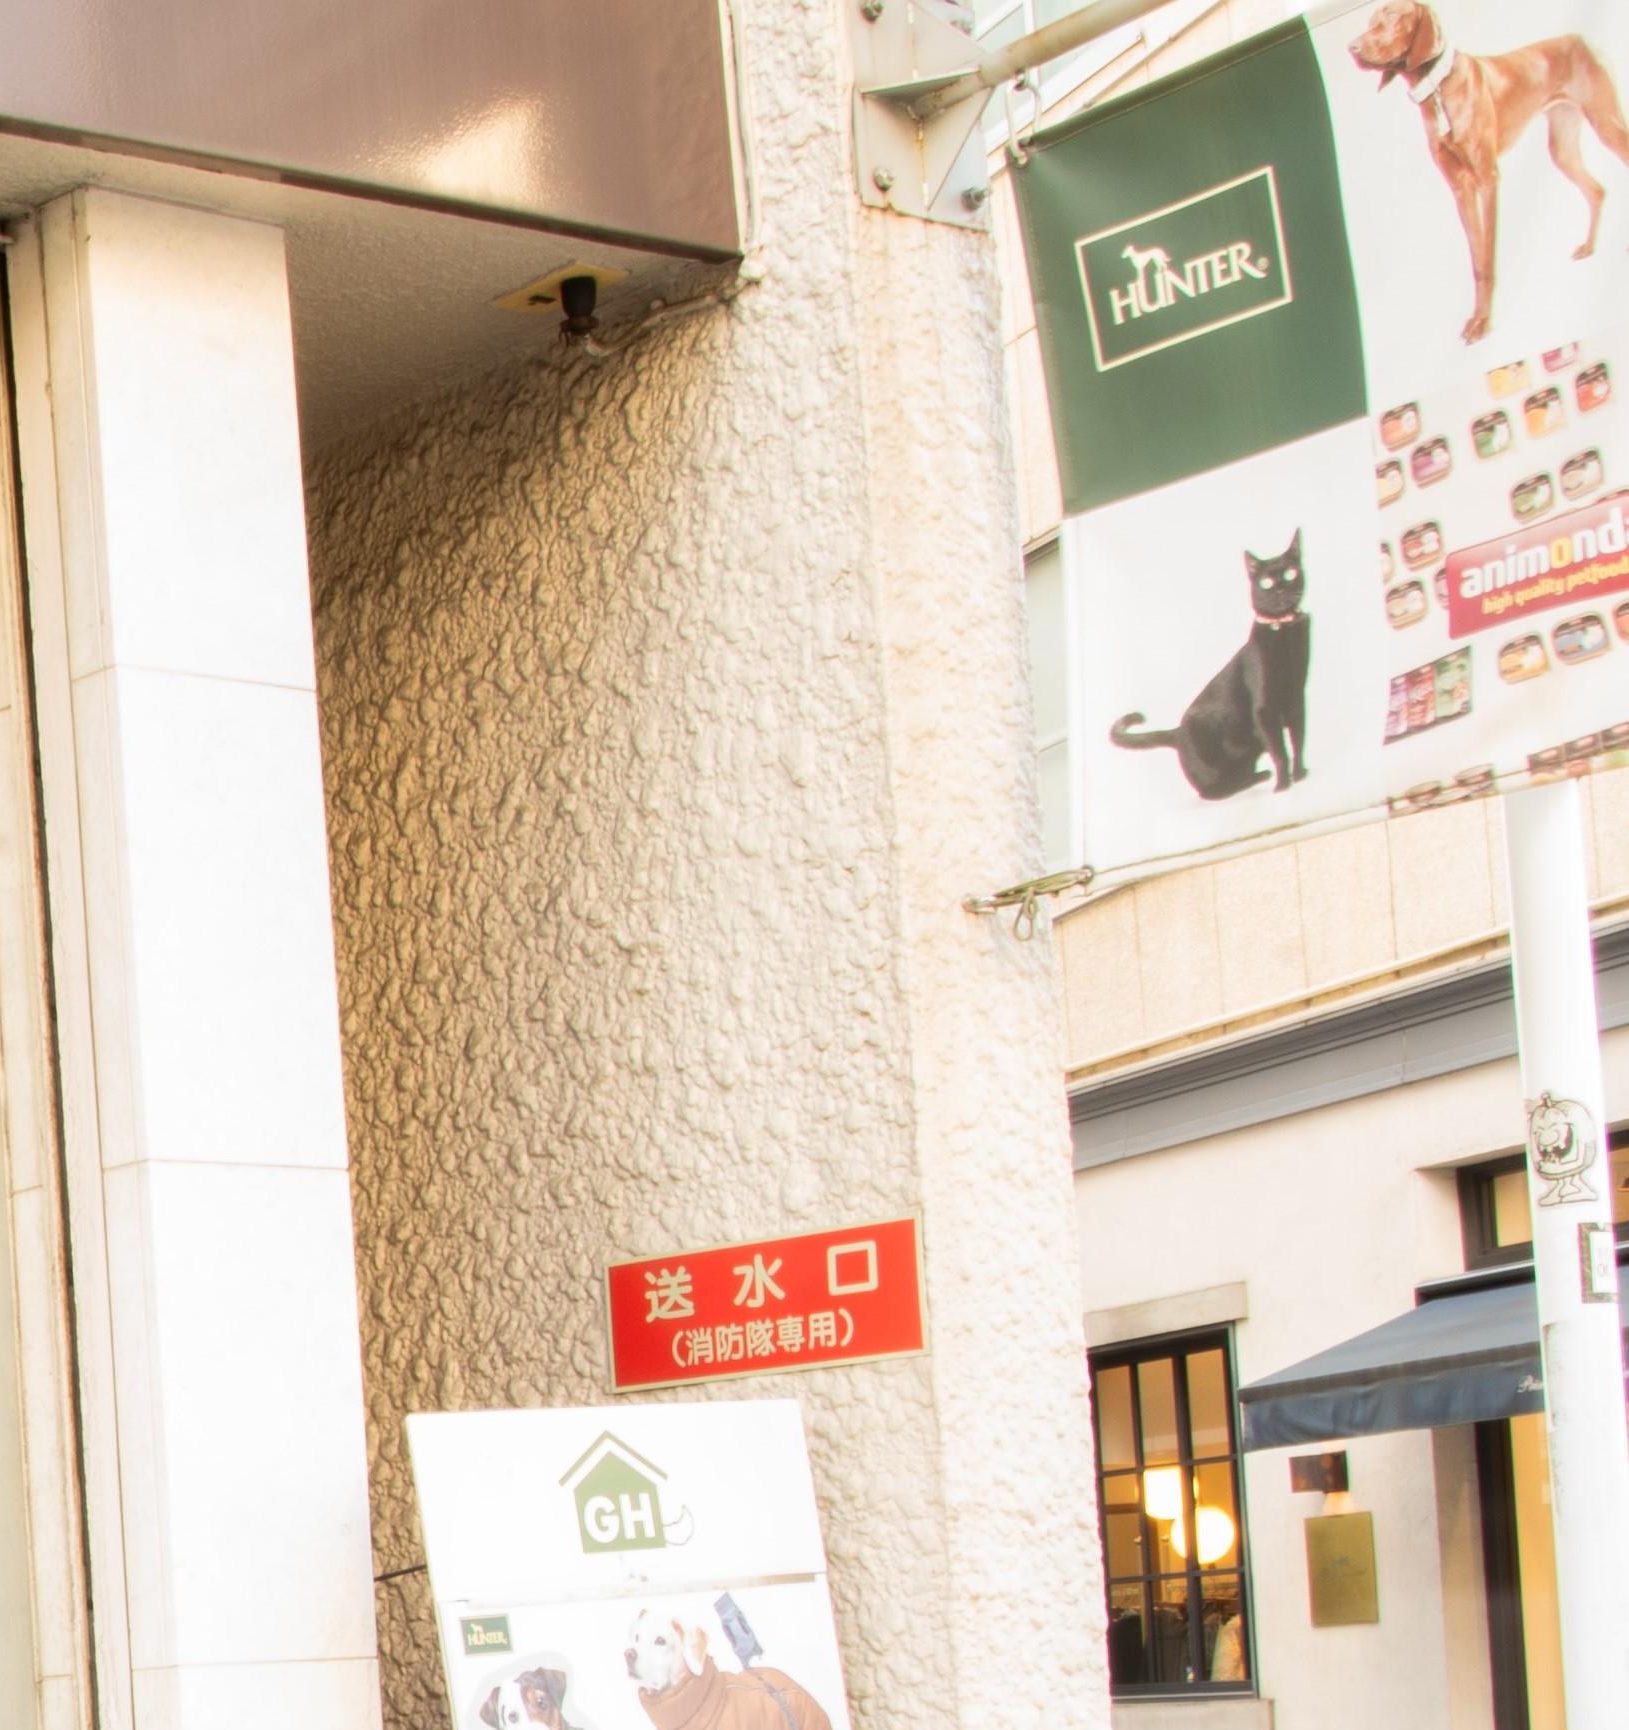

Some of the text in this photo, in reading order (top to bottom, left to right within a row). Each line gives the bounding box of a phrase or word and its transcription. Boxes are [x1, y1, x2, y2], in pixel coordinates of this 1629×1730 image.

[1109, 242, 1267, 325] HUNTER
[1460, 507, 1629, 598] animond
[1481, 591, 1513, 614] high
[1513, 577, 1564, 606] quality
[644, 1238, 879, 1324] 送水口
[583, 1492, 656, 1544] GH
